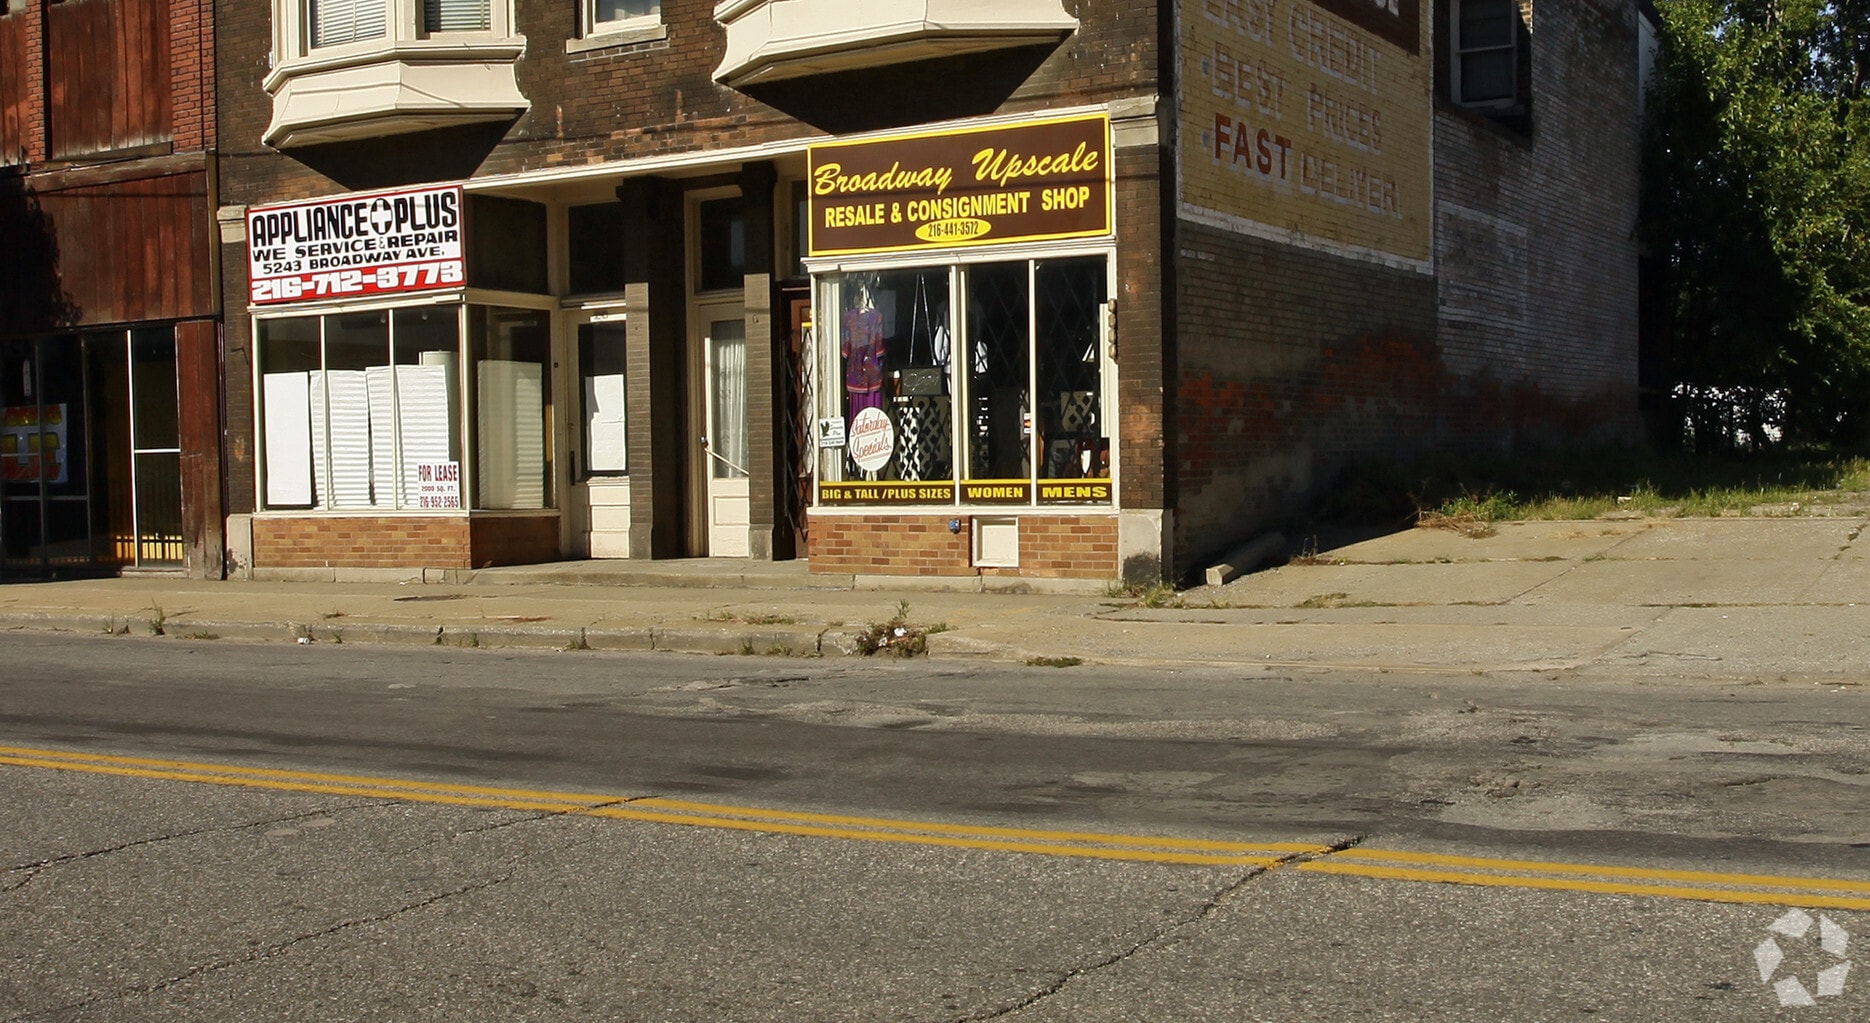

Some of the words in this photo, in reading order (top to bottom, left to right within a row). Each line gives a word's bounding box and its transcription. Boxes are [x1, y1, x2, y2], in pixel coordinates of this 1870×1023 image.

[1288, 2, 1382, 96] CREDIT
[1212, 41, 1290, 120] BEST
[1306, 82, 1382, 155] PRICES
[1215, 112, 1292, 180] FAST
[813, 161, 953, 195] Broadway
[971, 141, 1099, 187] Upscale
[252, 203, 369, 247] APPLIANCE
[394, 191, 457, 233] PLUS
[825, 204, 885, 228] RESALE
[890, 202, 902, 223] &
[907, 191, 1031, 221] CONSIGNMENT
[1041, 186, 1090, 211] SHOP
[927, 220, 979, 238] 216-441-3572
[253, 247, 286, 262] WE
[295, 238, 377, 258] SERVICE
[379, 236, 386, 249] &
[387, 230, 458, 248] REPAIR
[263, 261, 301, 274] 5243
[309, 250, 401, 270] BROADWAY
[251, 259, 464, 303] 216-712-3773
[852, 433, 891, 463] Specials
[419, 464, 432, 482] FOR
[435, 464, 457, 482] LEASE
[822, 486, 842, 499] BIG
[844, 487, 852, 499] &
[855, 486, 880, 499] TALL
[918, 487, 951, 499] SIZES
[967, 486, 1023, 498] WOMEN
[1042, 486, 1107, 498] MENS
